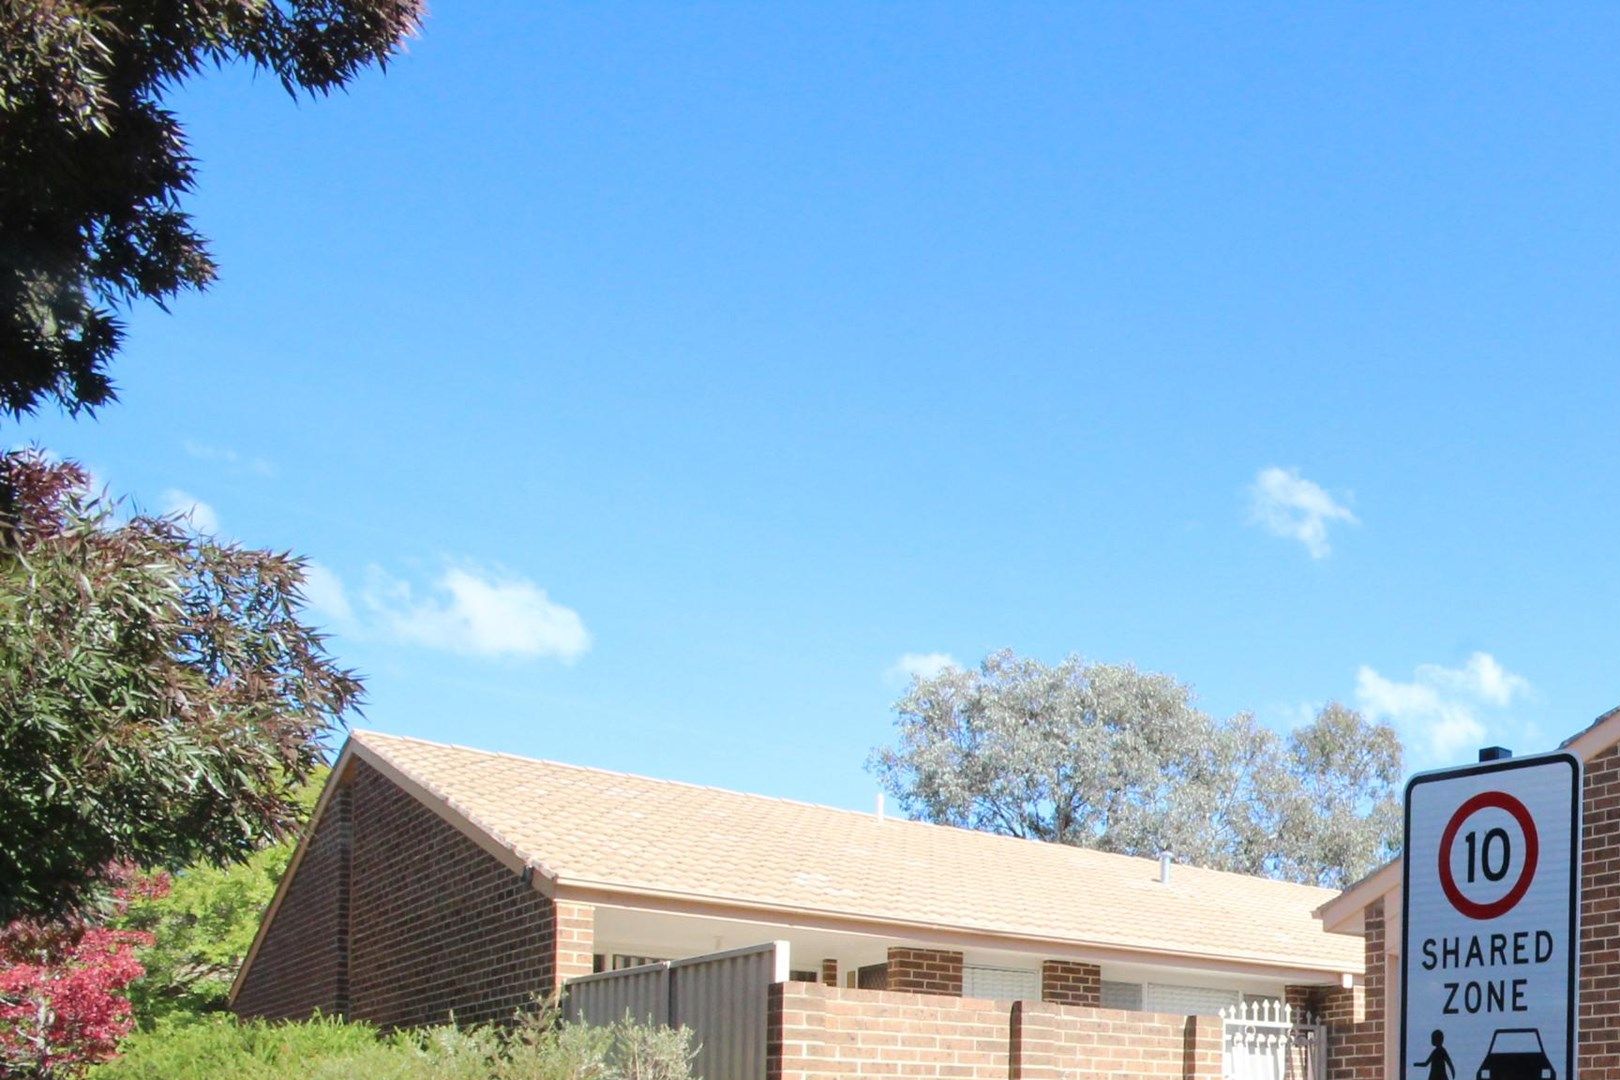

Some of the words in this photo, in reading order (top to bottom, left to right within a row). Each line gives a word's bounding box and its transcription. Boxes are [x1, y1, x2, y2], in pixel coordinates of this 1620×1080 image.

[1464, 827, 1511, 884] 10
[1421, 930, 1554, 971] SHARED
[1442, 978, 1528, 1015] ZONE
